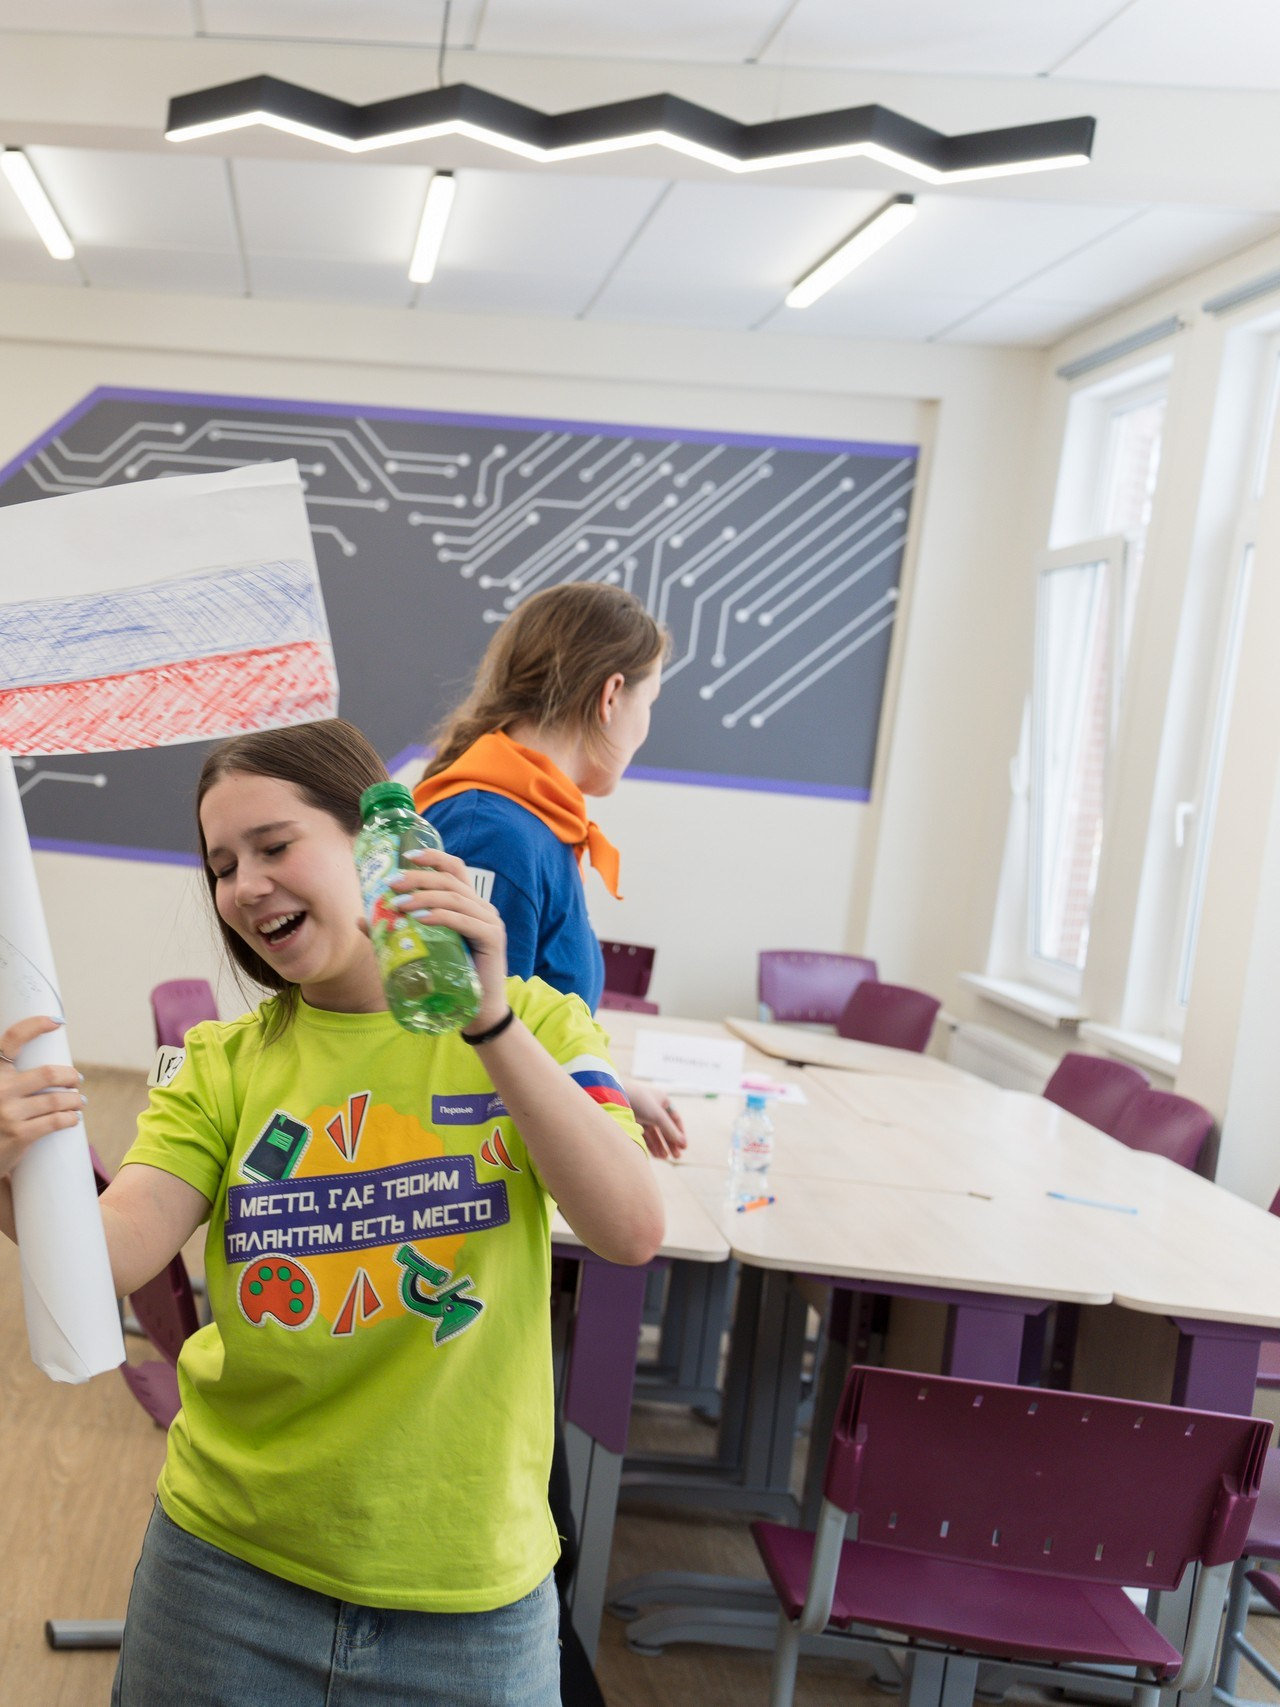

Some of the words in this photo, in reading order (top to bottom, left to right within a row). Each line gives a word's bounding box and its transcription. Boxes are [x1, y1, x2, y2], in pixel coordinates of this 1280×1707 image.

[439, 1105, 474, 1116] Первые
[239, 1191, 320, 1218] МЕСТО,
[327, 1184, 375, 1212] ГДЕ
[381, 1170, 460, 1201] ТВОИМ
[227, 1223, 343, 1254] ТАЛАНТАМ
[351, 1214, 406, 1241] ЕСТЬ
[412, 1198, 492, 1231] МЕСТО
